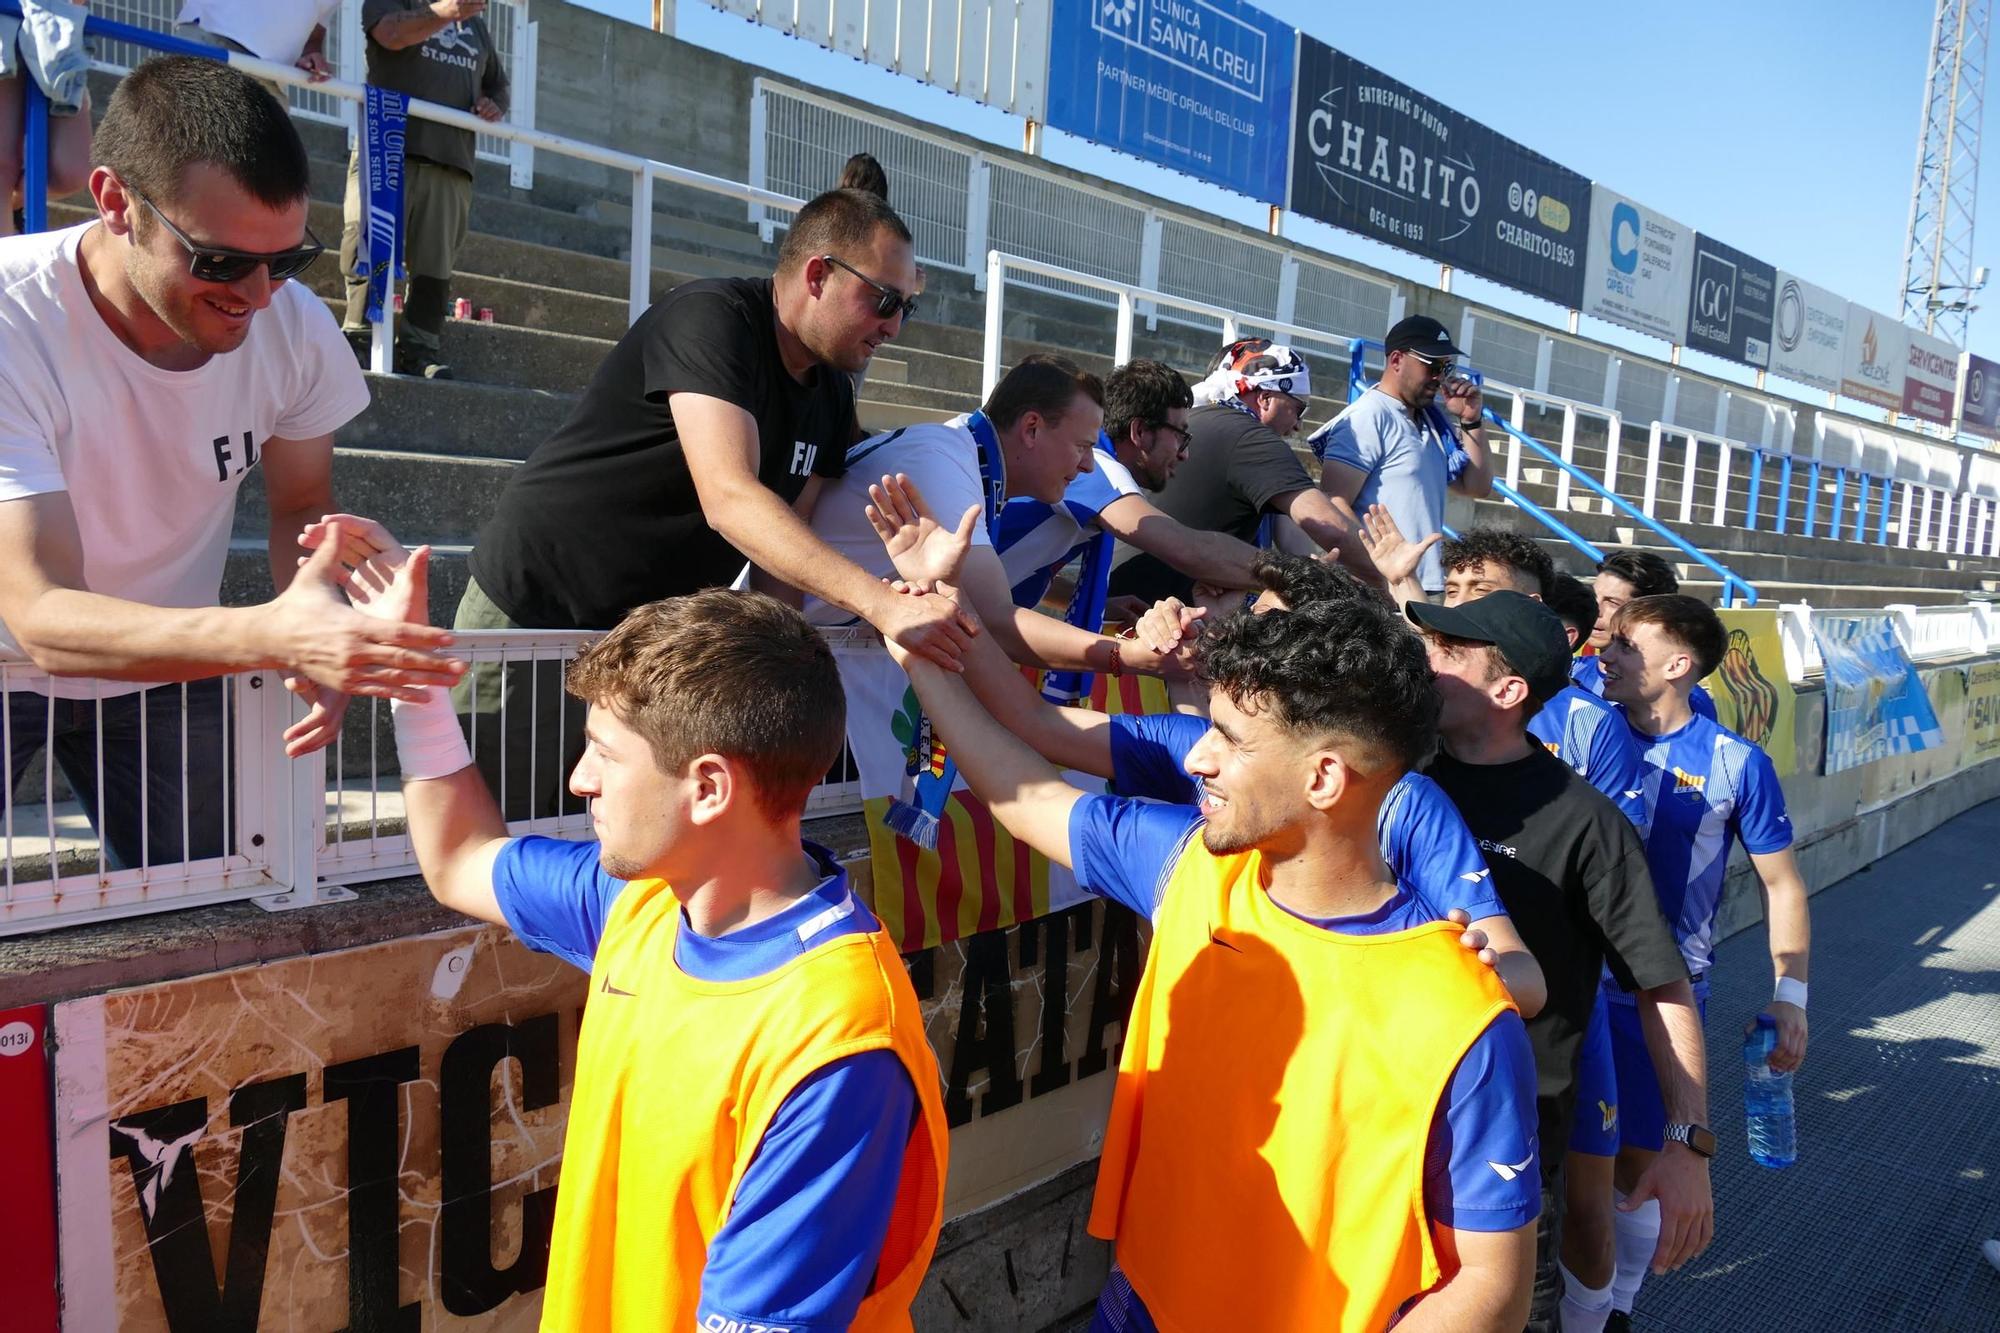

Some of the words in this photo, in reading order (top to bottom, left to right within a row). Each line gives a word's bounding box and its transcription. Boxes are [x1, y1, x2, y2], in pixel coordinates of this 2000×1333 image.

[1150, 17, 1209, 64] SANTA
[1213, 46, 1255, 84] CREU
[1097, 61, 1146, 92] PARTNER
[1179, 95, 1213, 121] OFICIAL
[1215, 109, 1232, 128] DEL
[1232, 118, 1255, 137] CLUB
[1358, 85, 1411, 115] ENTREPANS
[1413, 104, 1448, 142] D'AUTOR
[369, 119, 379, 145] SOM
[371, 156, 382, 192] SEREM
[1307, 108, 1480, 218] CHARITO
[1389, 214, 1401, 233] DE
[1403, 218, 1424, 241] 1953
[1496, 219, 1575, 267] CHARITO1953
[1700, 278, 1729, 322] GC
[1694, 320, 1707, 337] Real
[1709, 325, 1730, 344] Estate
